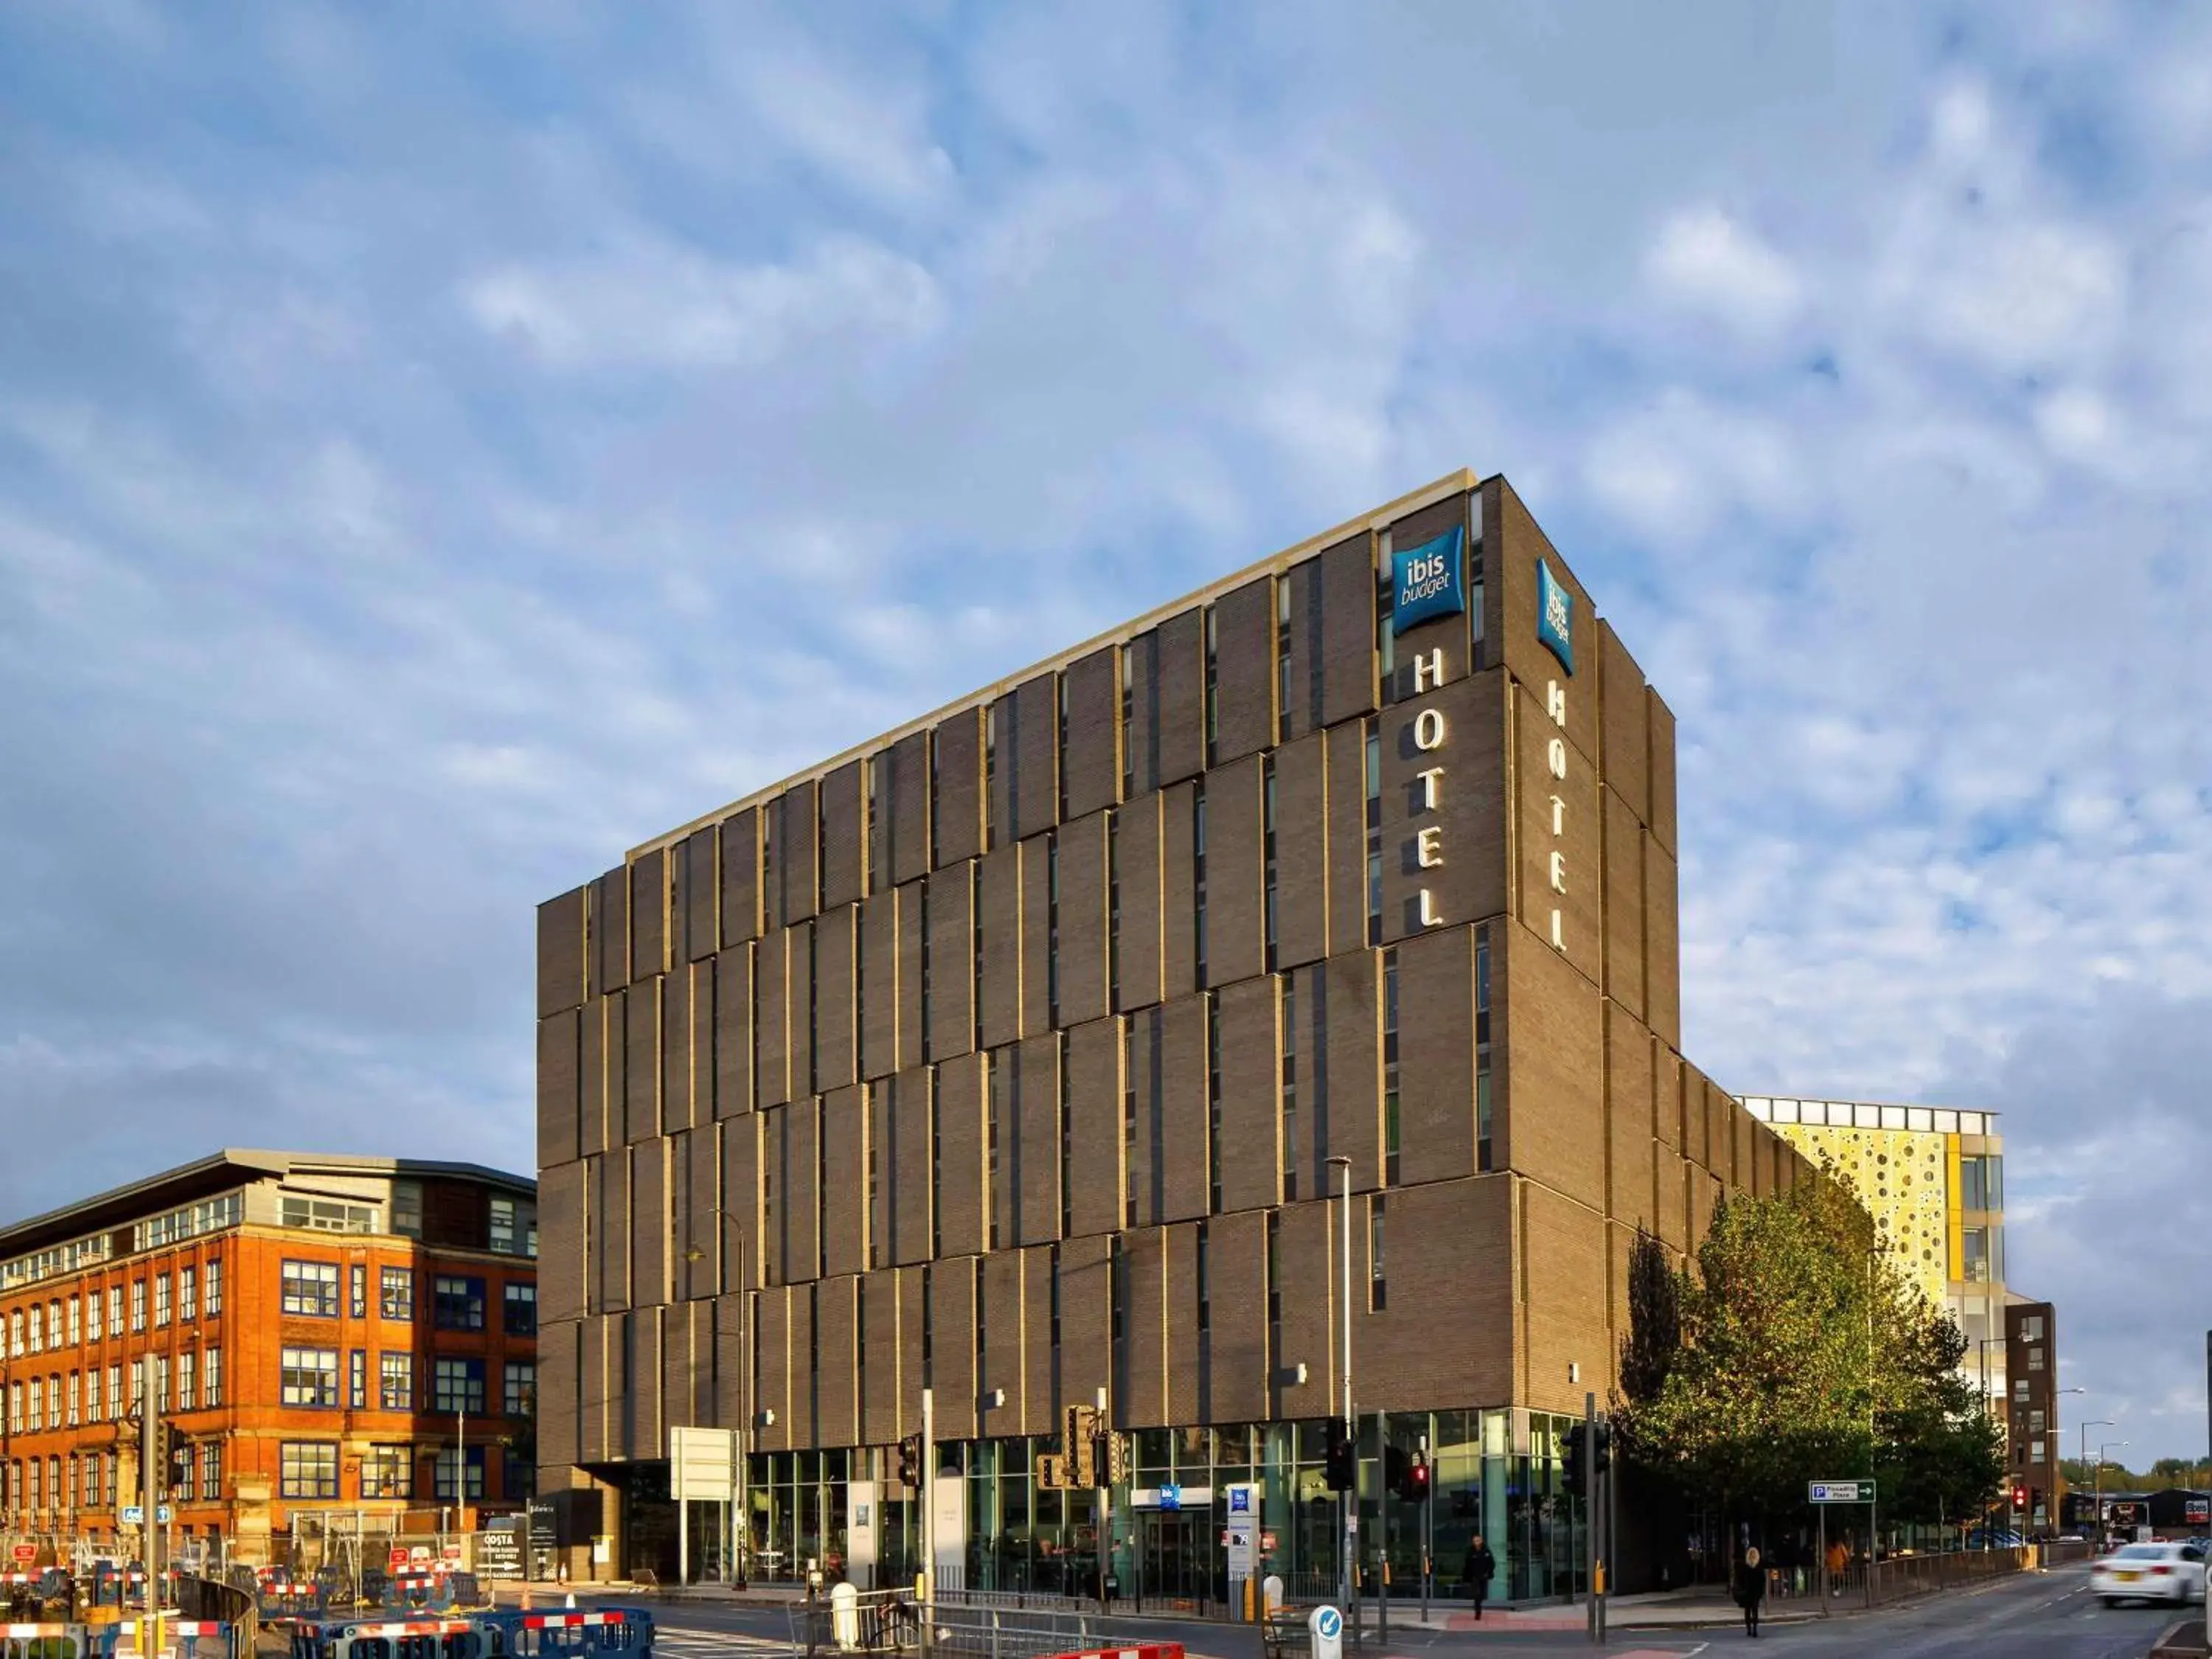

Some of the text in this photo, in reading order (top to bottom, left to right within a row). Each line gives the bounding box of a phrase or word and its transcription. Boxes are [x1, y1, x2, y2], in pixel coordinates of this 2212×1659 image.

[1401, 571, 1450, 605] budget
[1407, 552, 1445, 587] ibis
[1546, 603, 1569, 645] budget
[1549, 582, 1567, 625] ibis
[1413, 647, 1445, 928] HOTEL
[1548, 678, 1567, 953] HOTEL
[484, 1534, 514, 1546] COSTA
